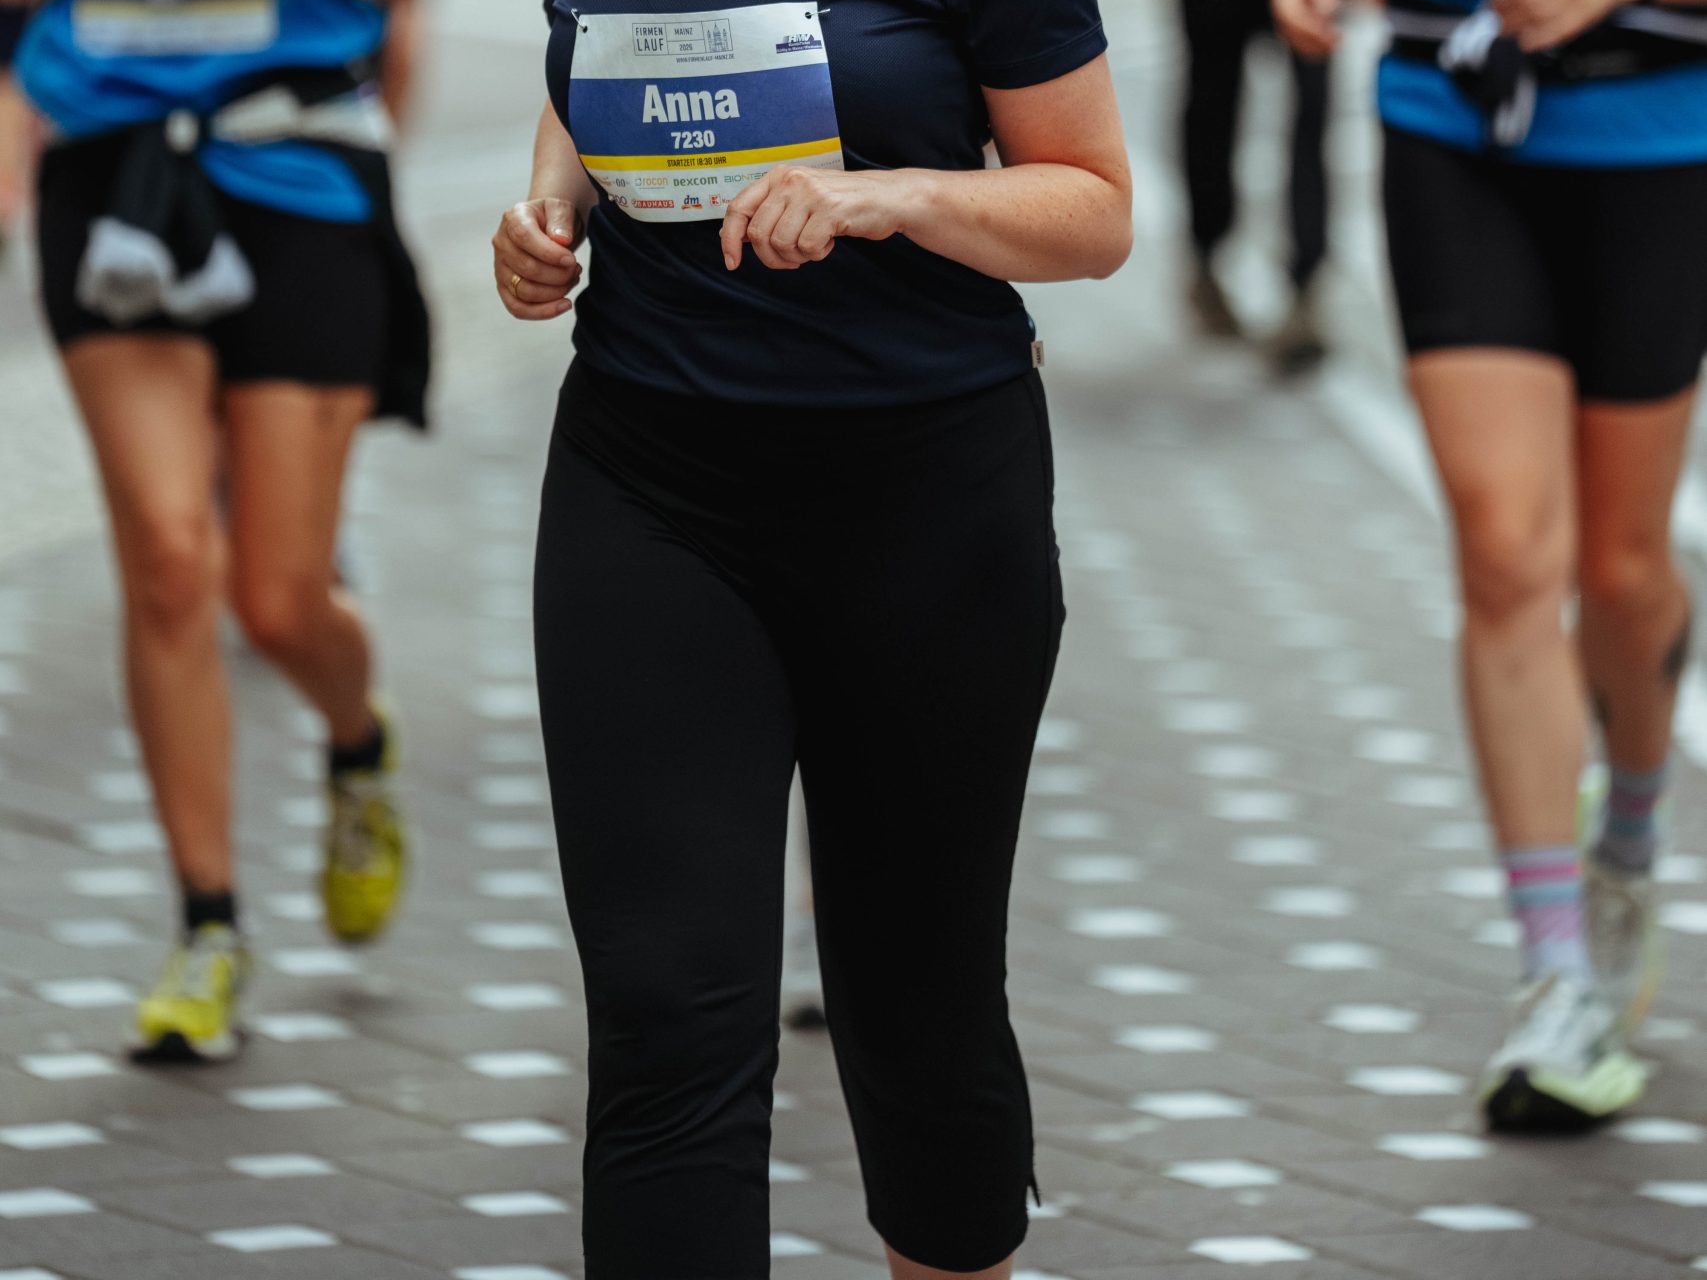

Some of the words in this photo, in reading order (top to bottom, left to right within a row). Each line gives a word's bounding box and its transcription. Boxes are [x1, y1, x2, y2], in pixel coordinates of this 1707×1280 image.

[635, 26, 663, 37] FIRMEN
[674, 27, 693, 36] MAINZ
[636, 38, 664, 52] LAUF
[642, 83, 740, 124] Anna
[670, 129, 716, 150] 7230
[667, 158, 695, 168] STARTZEIT
[696, 157, 712, 166] 18:30
[713, 156, 727, 165] UHR
[638, 200, 673, 208] BAUHAUS
[683, 195, 699, 205] dm
